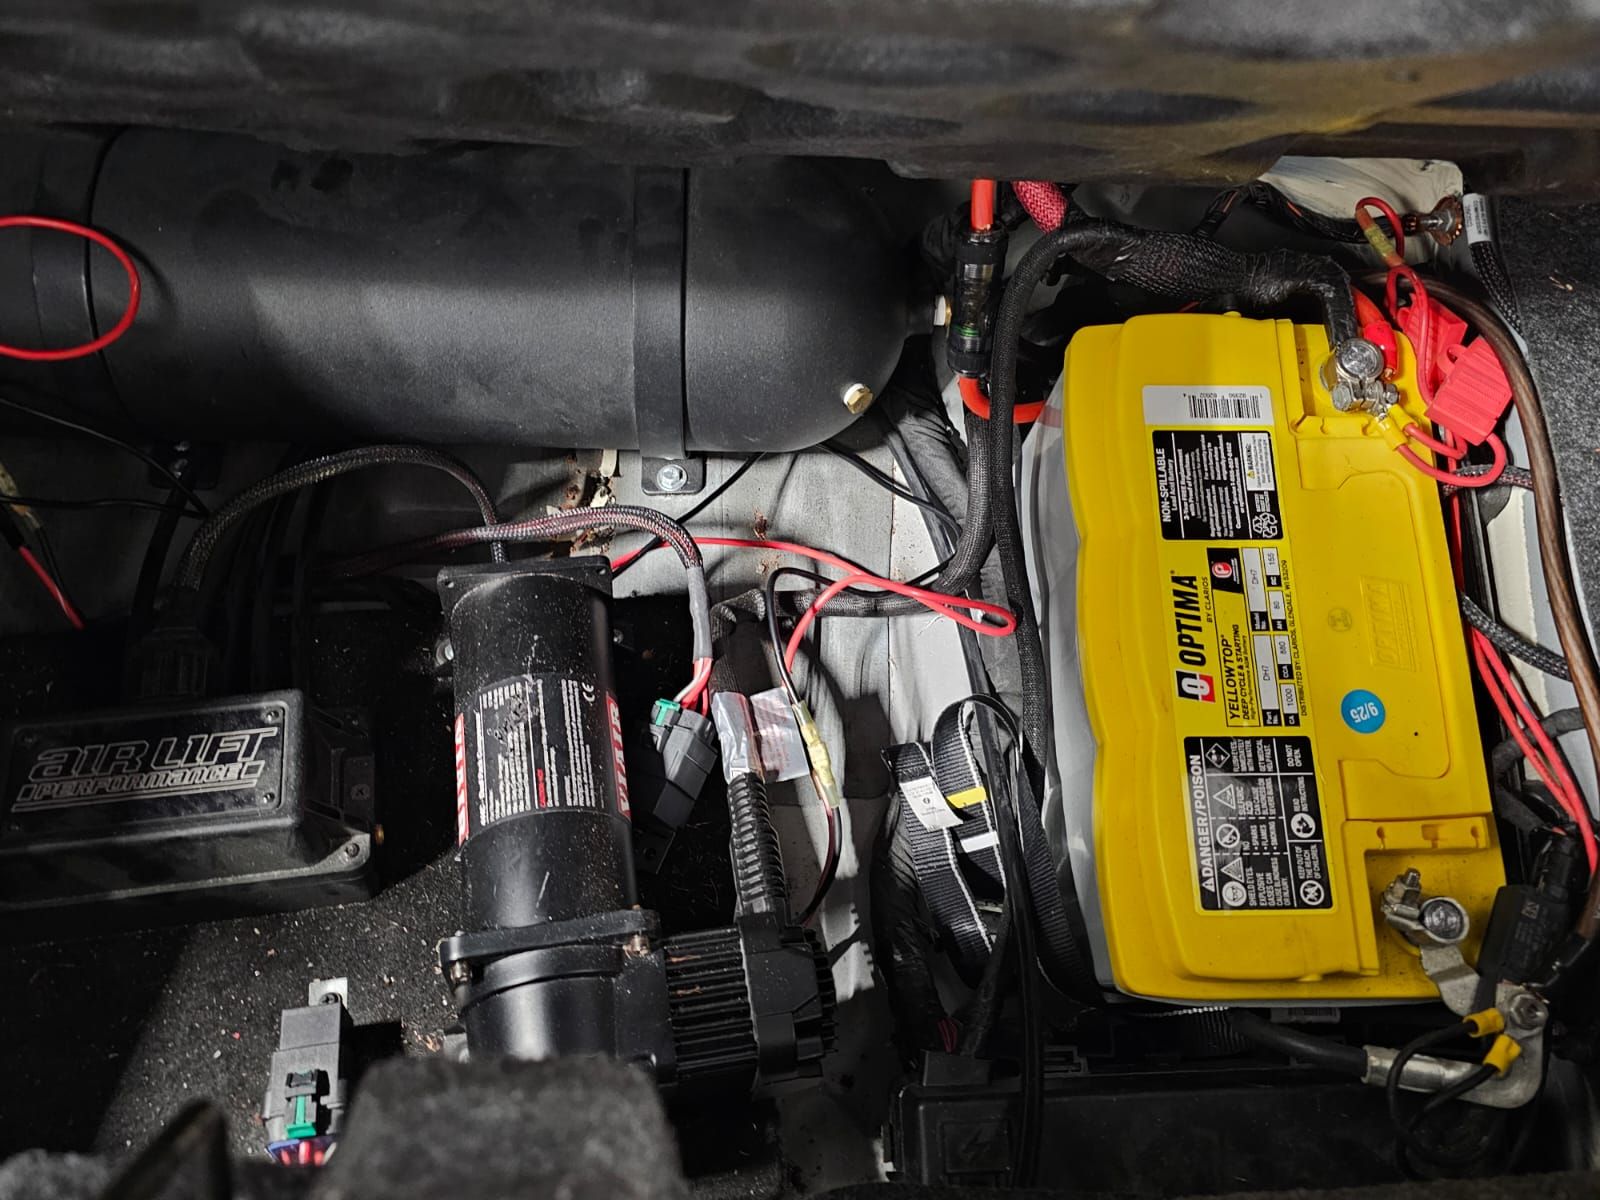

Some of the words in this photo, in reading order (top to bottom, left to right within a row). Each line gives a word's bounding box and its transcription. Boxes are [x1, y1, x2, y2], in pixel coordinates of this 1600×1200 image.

[1156, 448, 1171, 522] NON-SPILLABLE
[1250, 569, 1258, 584] DH7
[1281, 560, 1289, 580] 53209
[1202, 576, 1211, 610] CLARIOS
[1284, 582, 1290, 590] WI
[1206, 611, 1213, 623] BY
[1287, 592, 1295, 627] GLENDALE,
[1171, 576, 1206, 666] OPTIMA
[1232, 624, 1243, 662] STARTING
[1290, 629, 1299, 659] CLARIOS,
[1222, 639, 1240, 719] YELLOWTOP
[1262, 665, 1270, 681] DH7
[582, 682, 595, 702] CE
[1238, 672, 1247, 697] CYCLE
[1296, 671, 1307, 716] DISTRIBUTED
[1285, 688, 1294, 706] 1000
[1241, 699, 1249, 720] DEEP
[1289, 715, 1295, 724] CA
[1349, 702, 1379, 724] 9/25
[150, 727, 279, 768] LIFT
[611, 702, 630, 812] VIAIR
[1285, 744, 1293, 757] NOT
[1287, 757, 1295, 767] DO
[1294, 749, 1302, 767] OPEN.
[1292, 798, 1300, 812] READ
[1190, 754, 1213, 877] DANGER/POISON
[1250, 825, 1259, 846] SPARKS
[1260, 824, 1269, 846] FLAMES
[1242, 841, 1250, 850] NO
[1296, 853, 1304, 865] OUT
[1265, 872, 1273, 884] CAN
[1297, 866, 1305, 879] KEEP
[1314, 871, 1321, 879] OF
[1256, 872, 1267, 906] EXPLOSIVE
[1266, 885, 1275, 906] GASES
[1274, 888, 1283, 906] CAUSE
